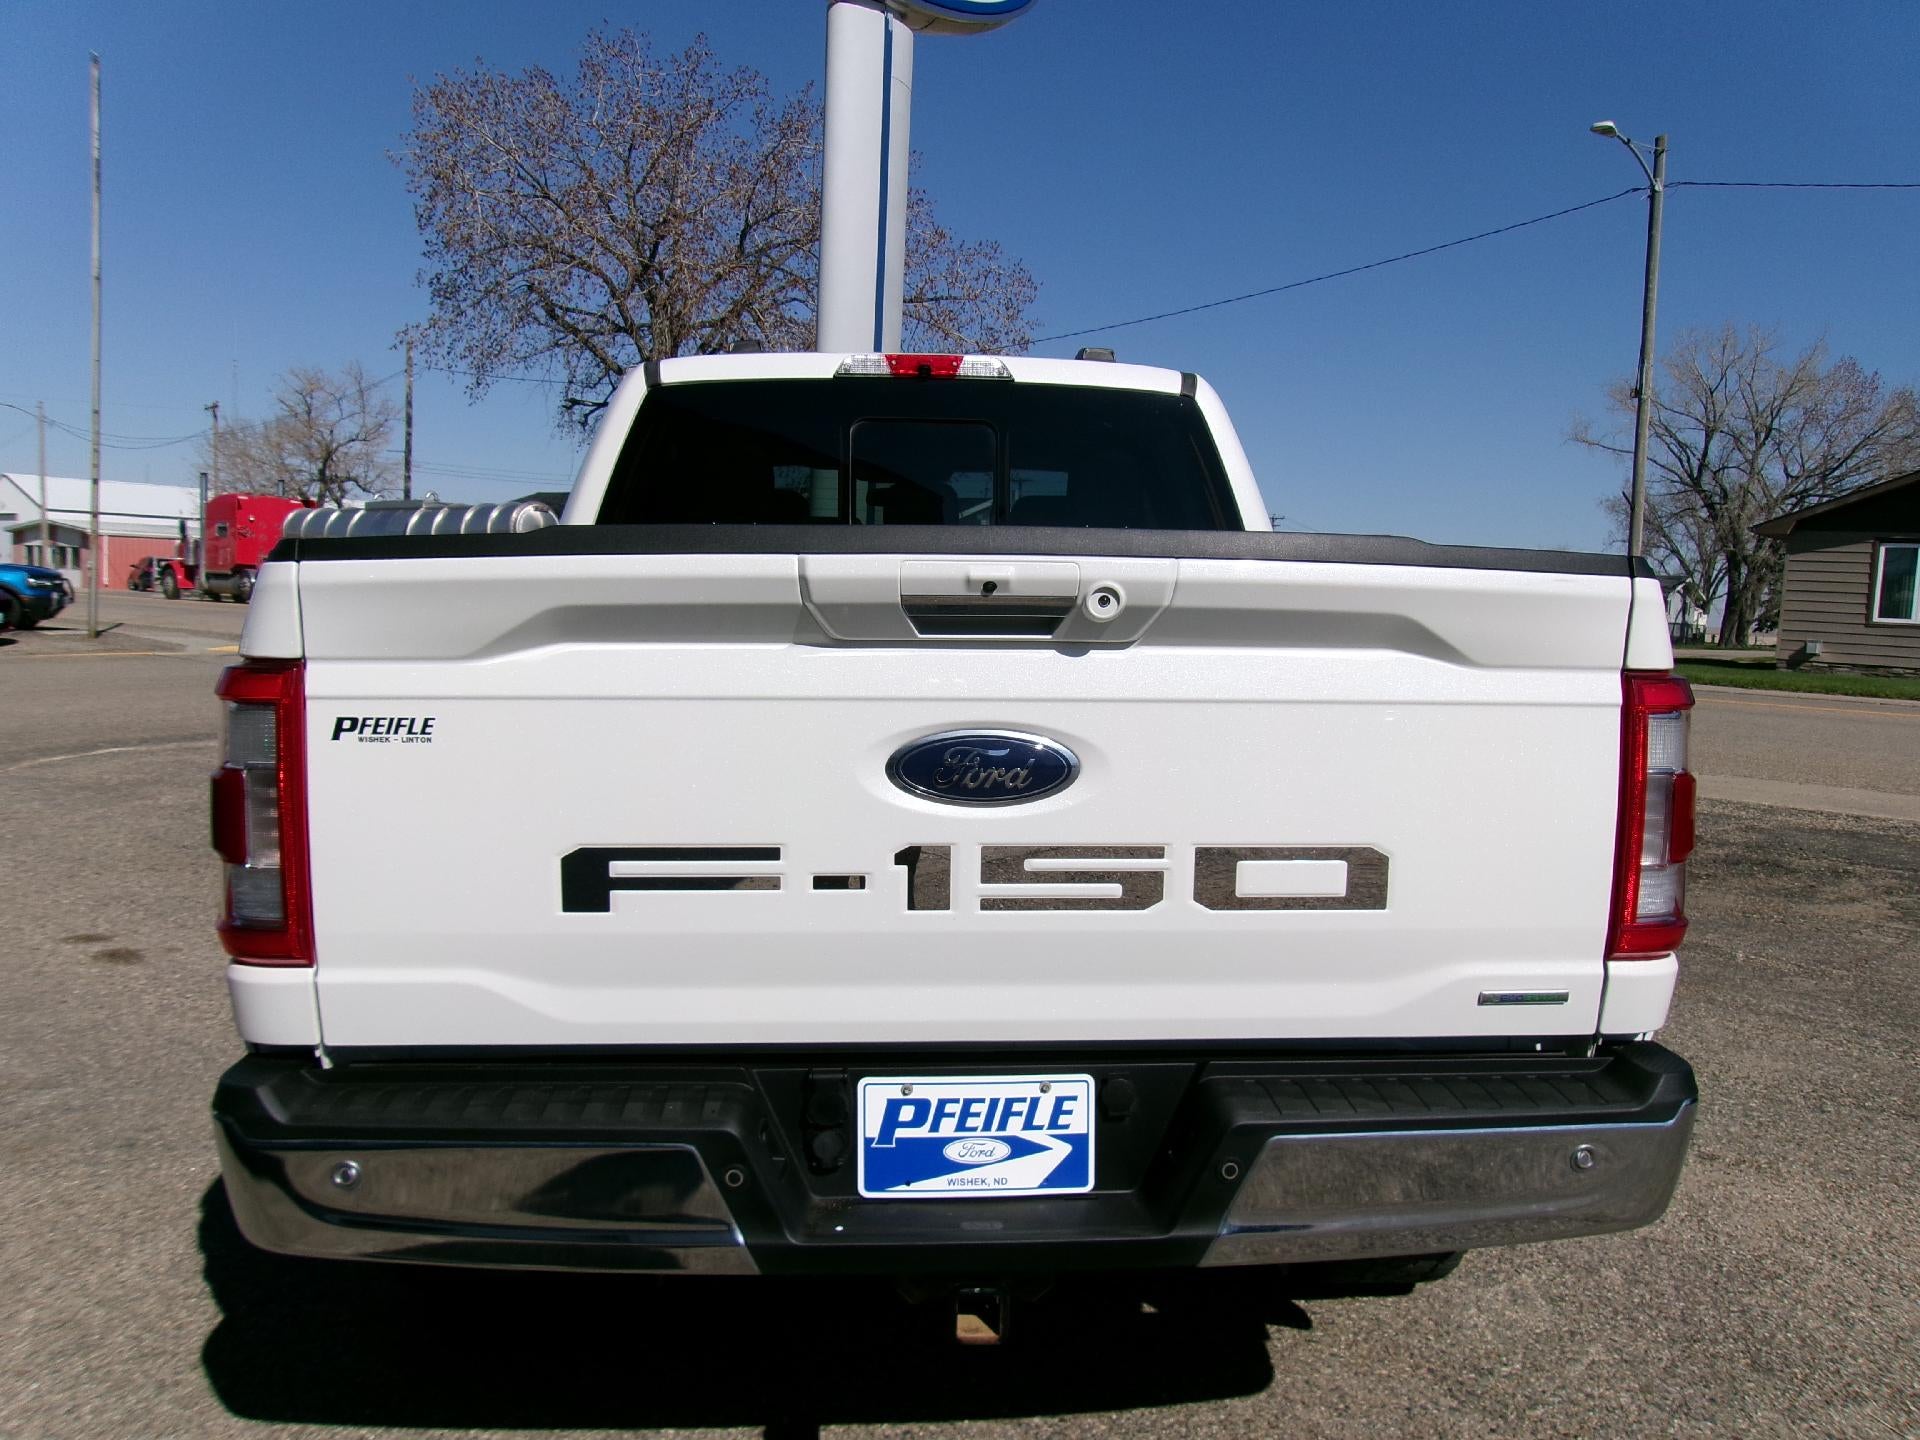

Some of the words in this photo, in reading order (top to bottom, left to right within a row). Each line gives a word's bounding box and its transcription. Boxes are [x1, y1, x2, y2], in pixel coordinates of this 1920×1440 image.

[331, 716, 436, 740] PFEIFLE
[932, 746, 1036, 790] Ford
[561, 846, 1389, 912] F-150
[871, 1095, 1079, 1147] PFEIFLE
[957, 1142, 996, 1159] Ford
[946, 1178, 991, 1188] WISHEK,
[993, 1177, 1008, 1186] ND
